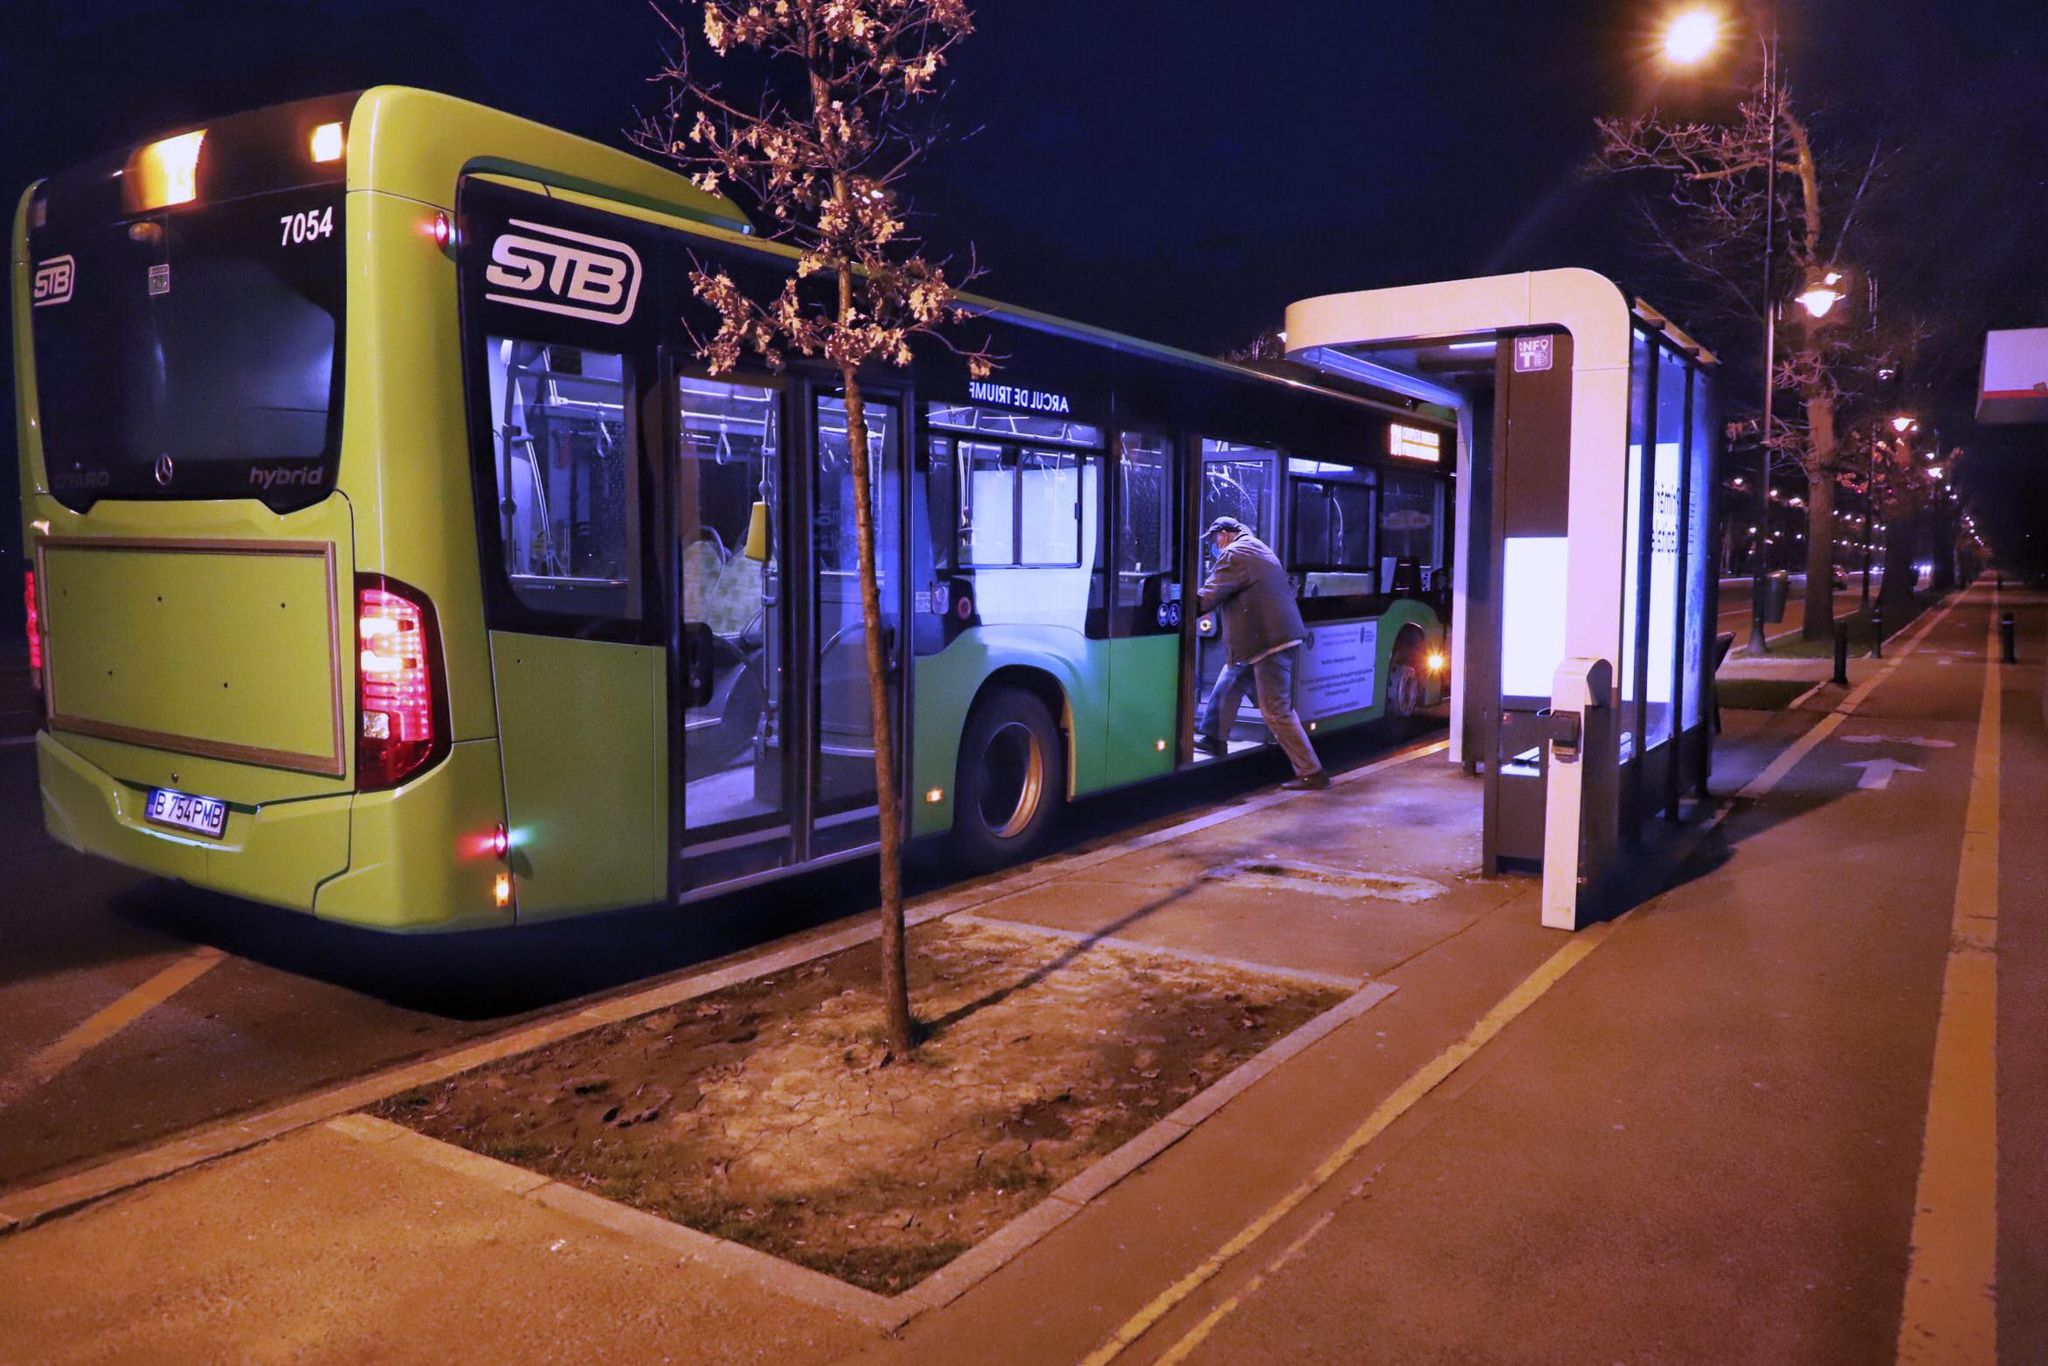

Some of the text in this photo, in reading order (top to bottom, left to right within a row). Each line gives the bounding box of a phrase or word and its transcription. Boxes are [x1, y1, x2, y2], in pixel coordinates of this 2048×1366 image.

[281, 206, 333, 246] 7054
[34, 264, 71, 298] STB
[485, 233, 628, 306] STB
[251, 467, 323, 489] hybrid
[155, 793, 166, 815] B
